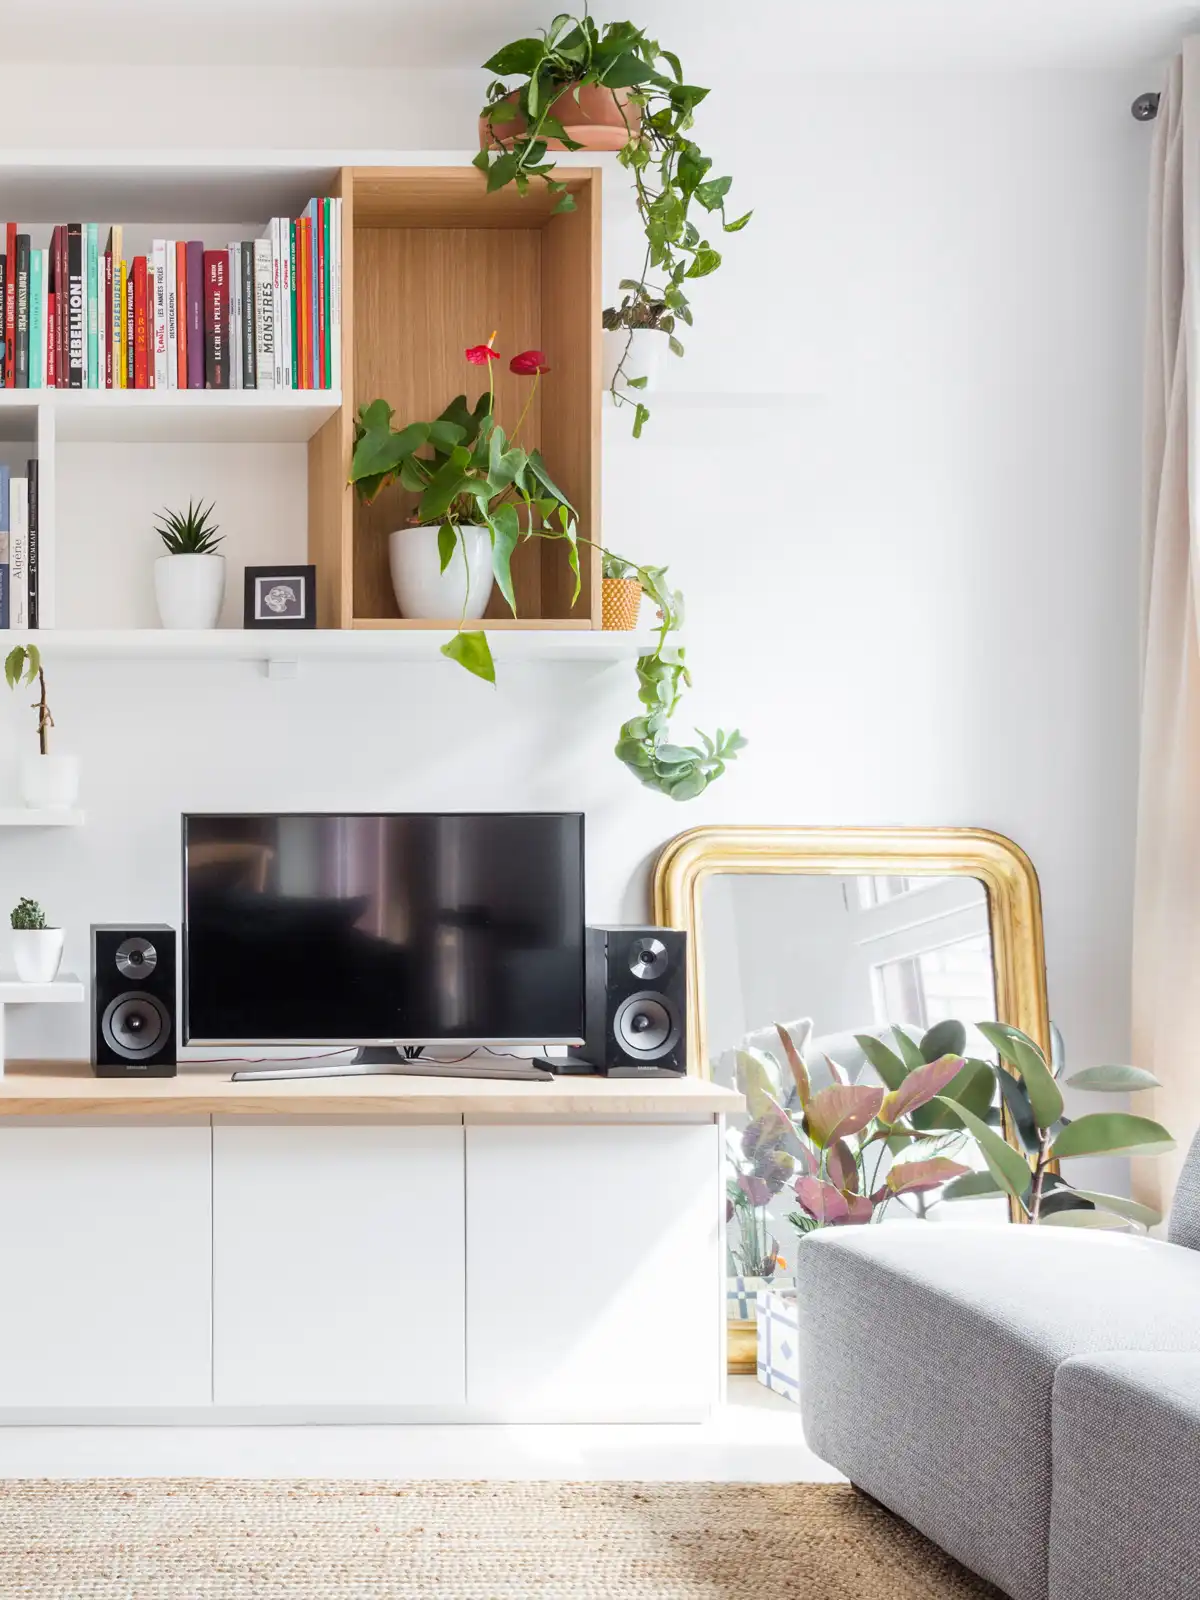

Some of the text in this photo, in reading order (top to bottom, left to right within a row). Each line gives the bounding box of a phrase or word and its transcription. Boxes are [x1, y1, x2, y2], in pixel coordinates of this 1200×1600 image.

[18, 271, 27, 310] PROFESSION
[112, 267, 121, 343] LA PRÉSIDENTE
[127, 310, 134, 318] ET
[213, 291, 221, 320] PEUPLE
[262, 282, 273, 354] MONSTRES
[213, 322, 221, 334] DU
[213, 335, 221, 350] CRI
[213, 350, 221, 360] LE
[12, 538, 23, 580] Algérie
